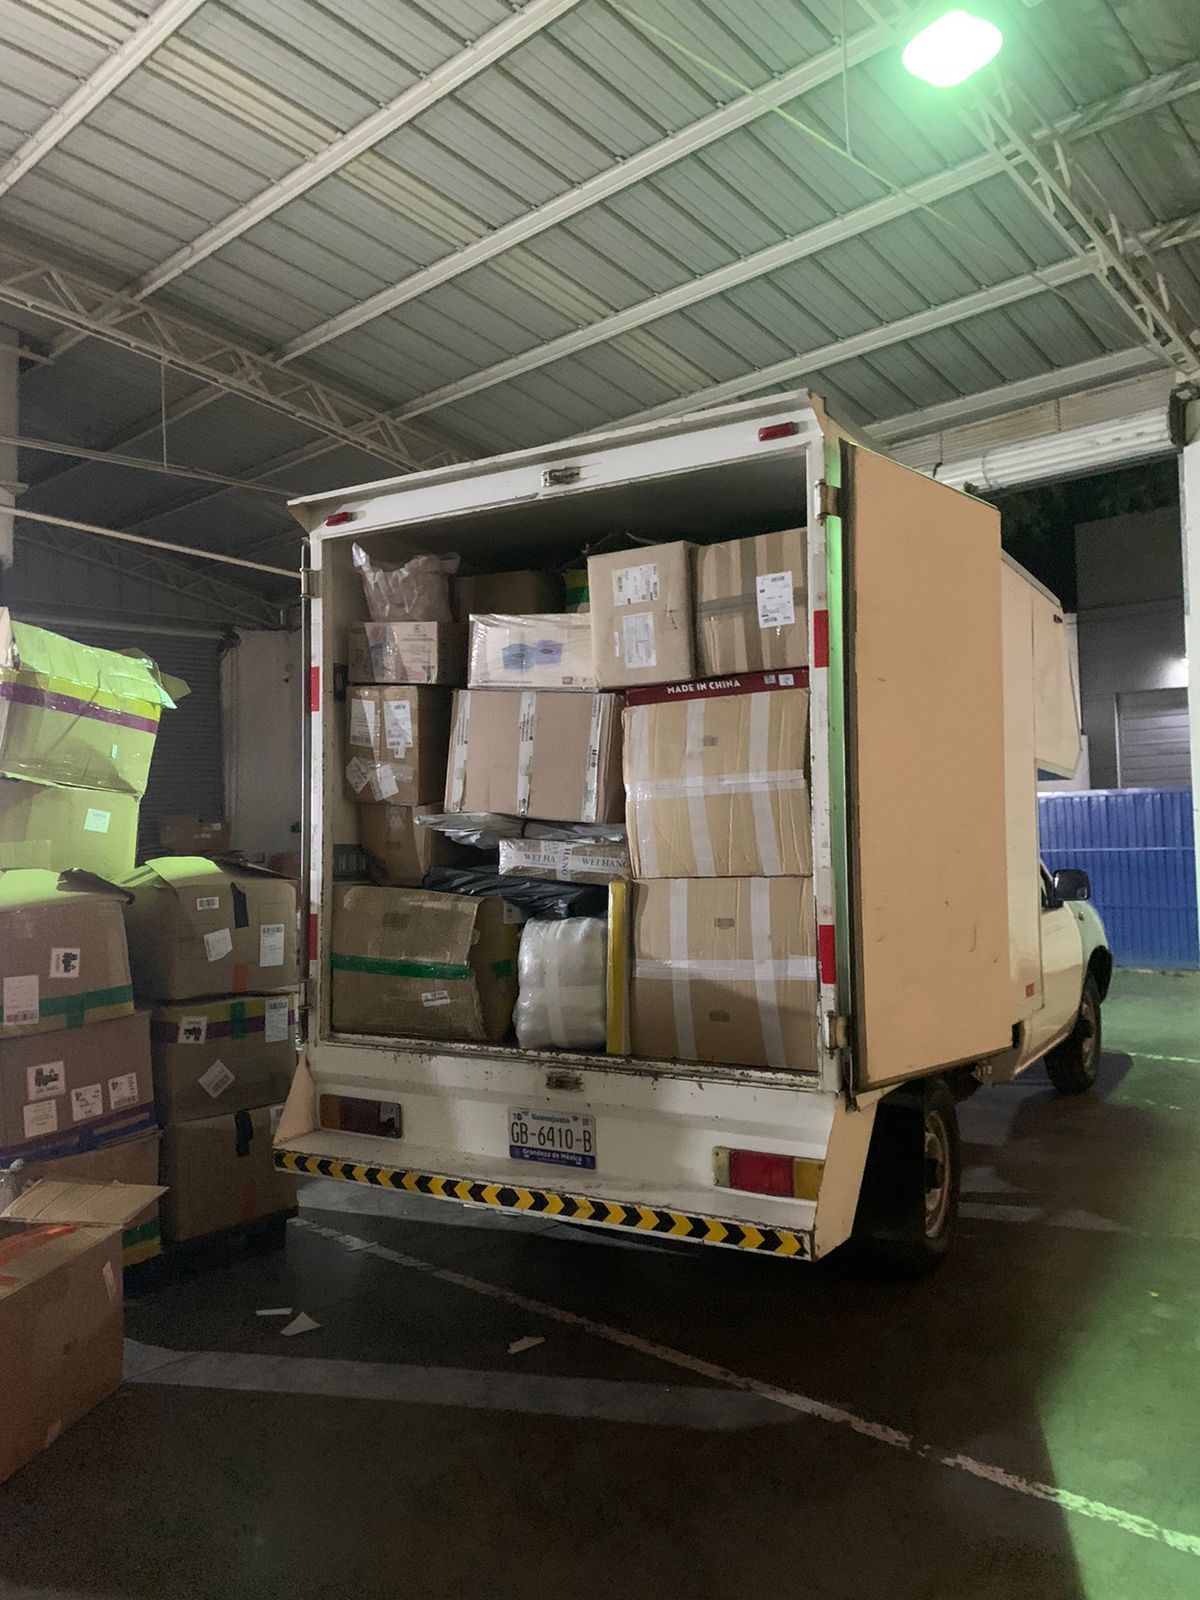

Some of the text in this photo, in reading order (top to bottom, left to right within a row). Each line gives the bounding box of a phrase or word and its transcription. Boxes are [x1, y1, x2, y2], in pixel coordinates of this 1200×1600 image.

[666, 680, 741, 694] MADE IN CHINA
[511, 1121, 592, 1153] GB-6410-B
